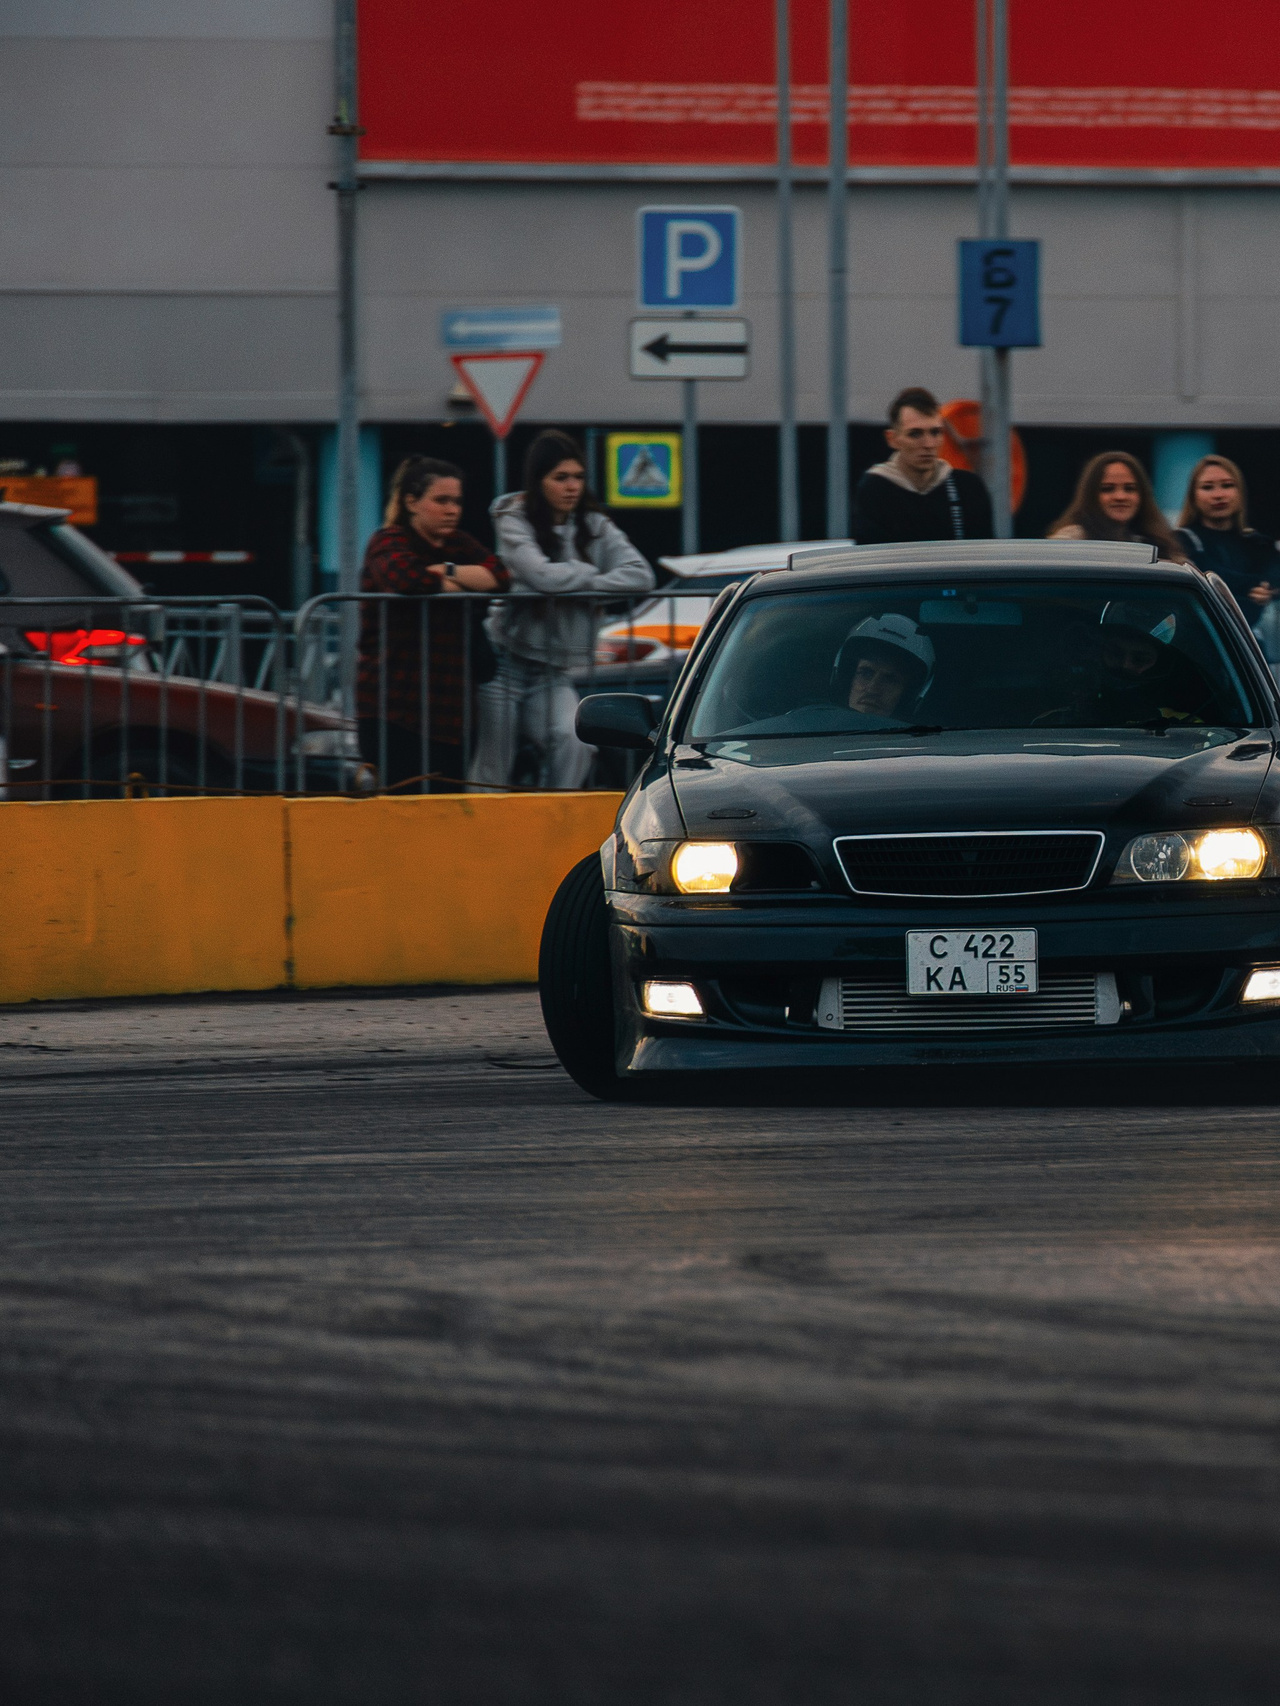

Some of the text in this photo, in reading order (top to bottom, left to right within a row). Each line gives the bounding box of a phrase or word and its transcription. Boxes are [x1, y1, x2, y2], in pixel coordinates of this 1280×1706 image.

[666, 219, 722, 298] P
[984, 296, 1012, 334] 7
[964, 934, 1014, 958] 422
[998, 965, 1025, 984] 55
